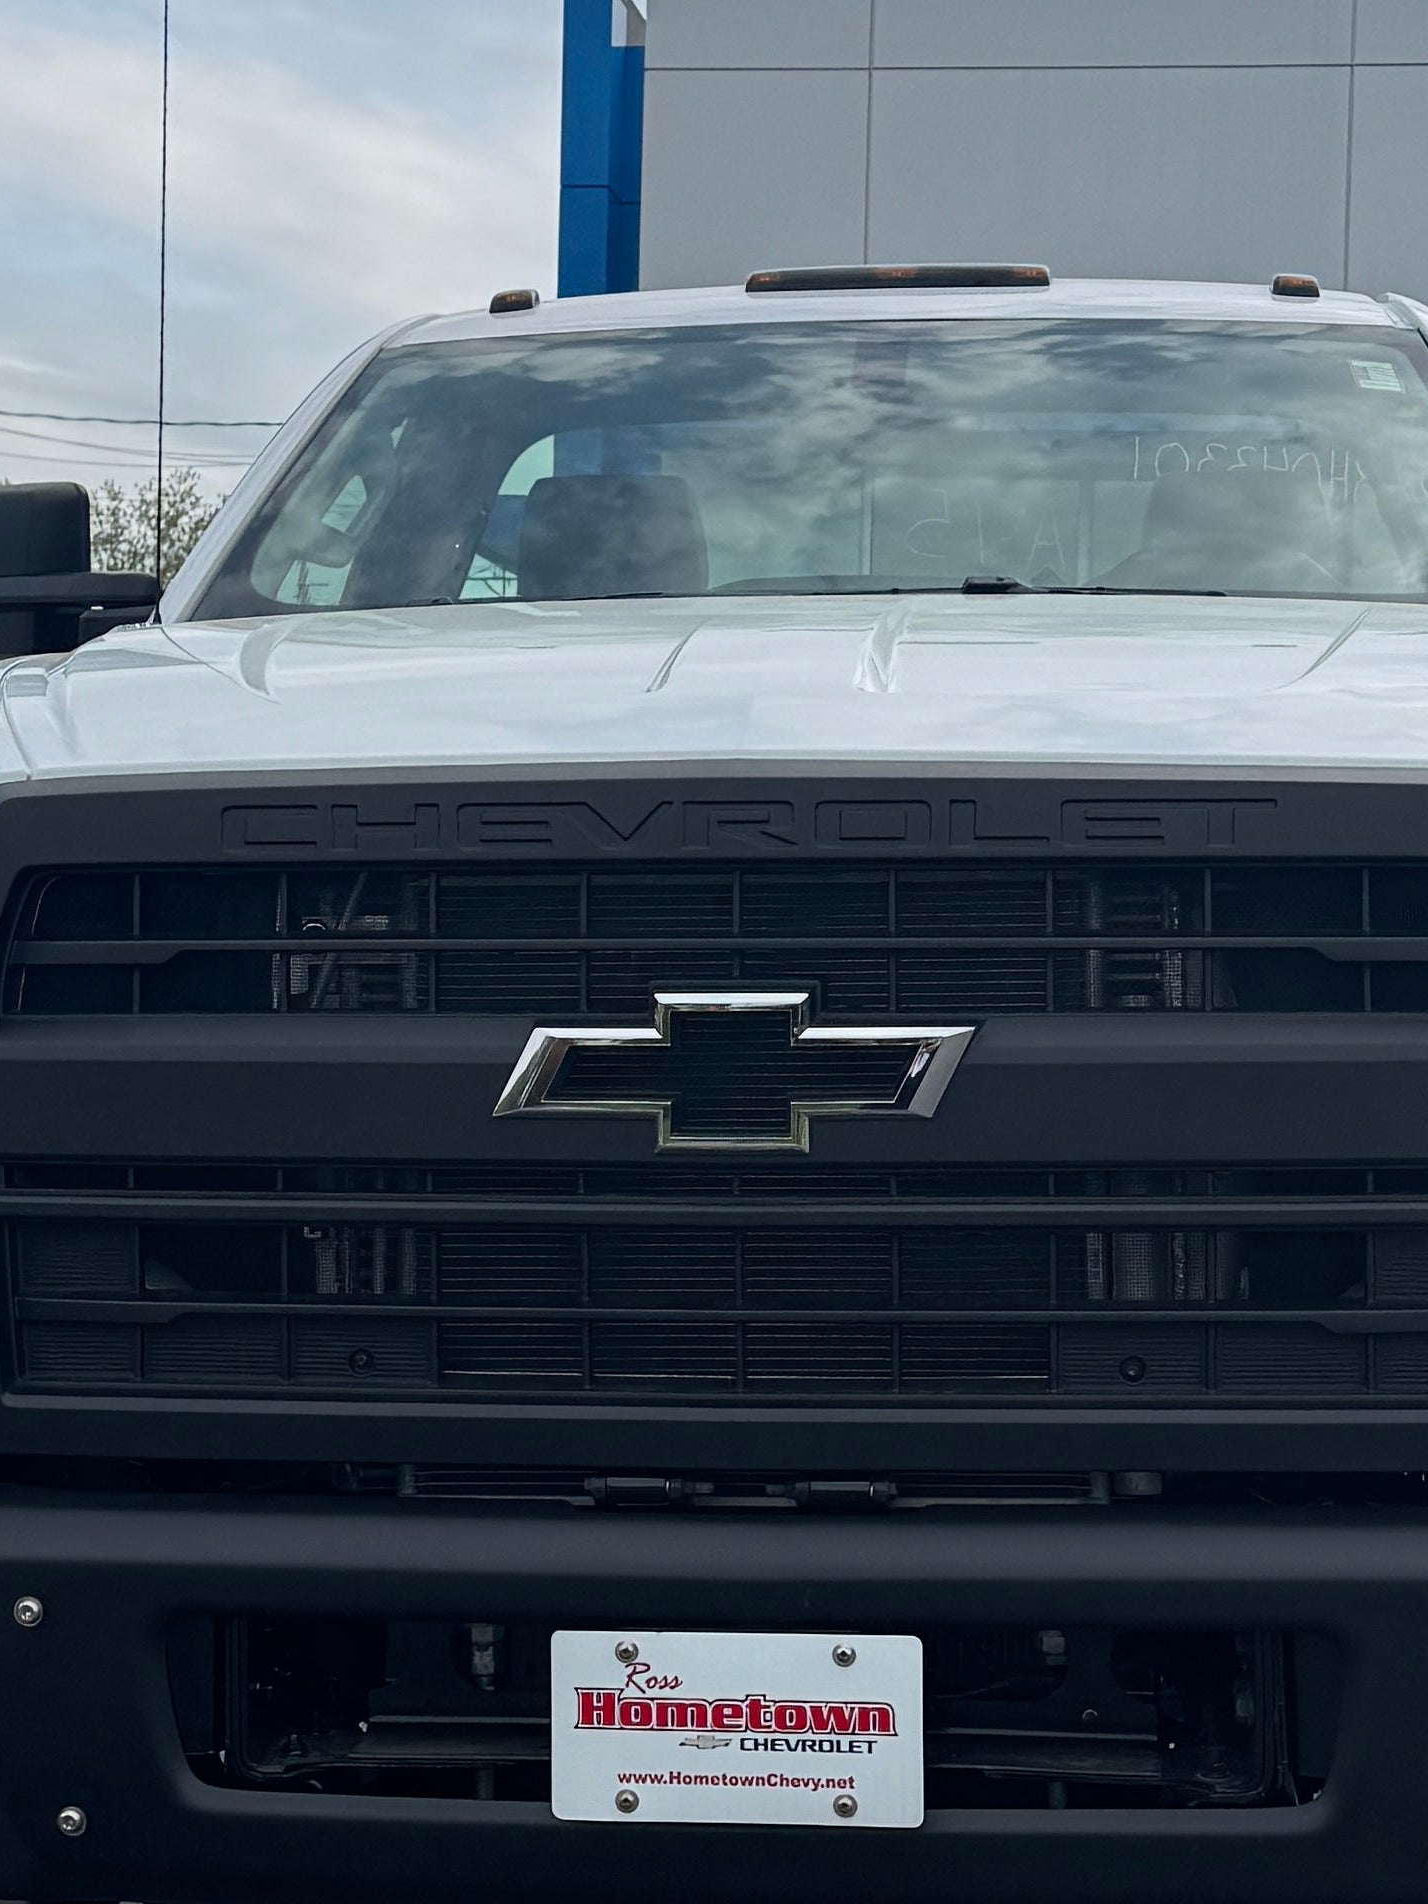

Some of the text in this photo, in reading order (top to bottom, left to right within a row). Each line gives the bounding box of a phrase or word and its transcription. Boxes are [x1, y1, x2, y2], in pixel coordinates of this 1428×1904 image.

[221, 798, 1278, 852] CHEVROLET
[624, 1662, 683, 1694] Ross
[574, 1687, 899, 1737] Hometown
[739, 1737, 878, 1754] CHEVROLET
[617, 1770, 856, 1792] www.HometownChevy.net
